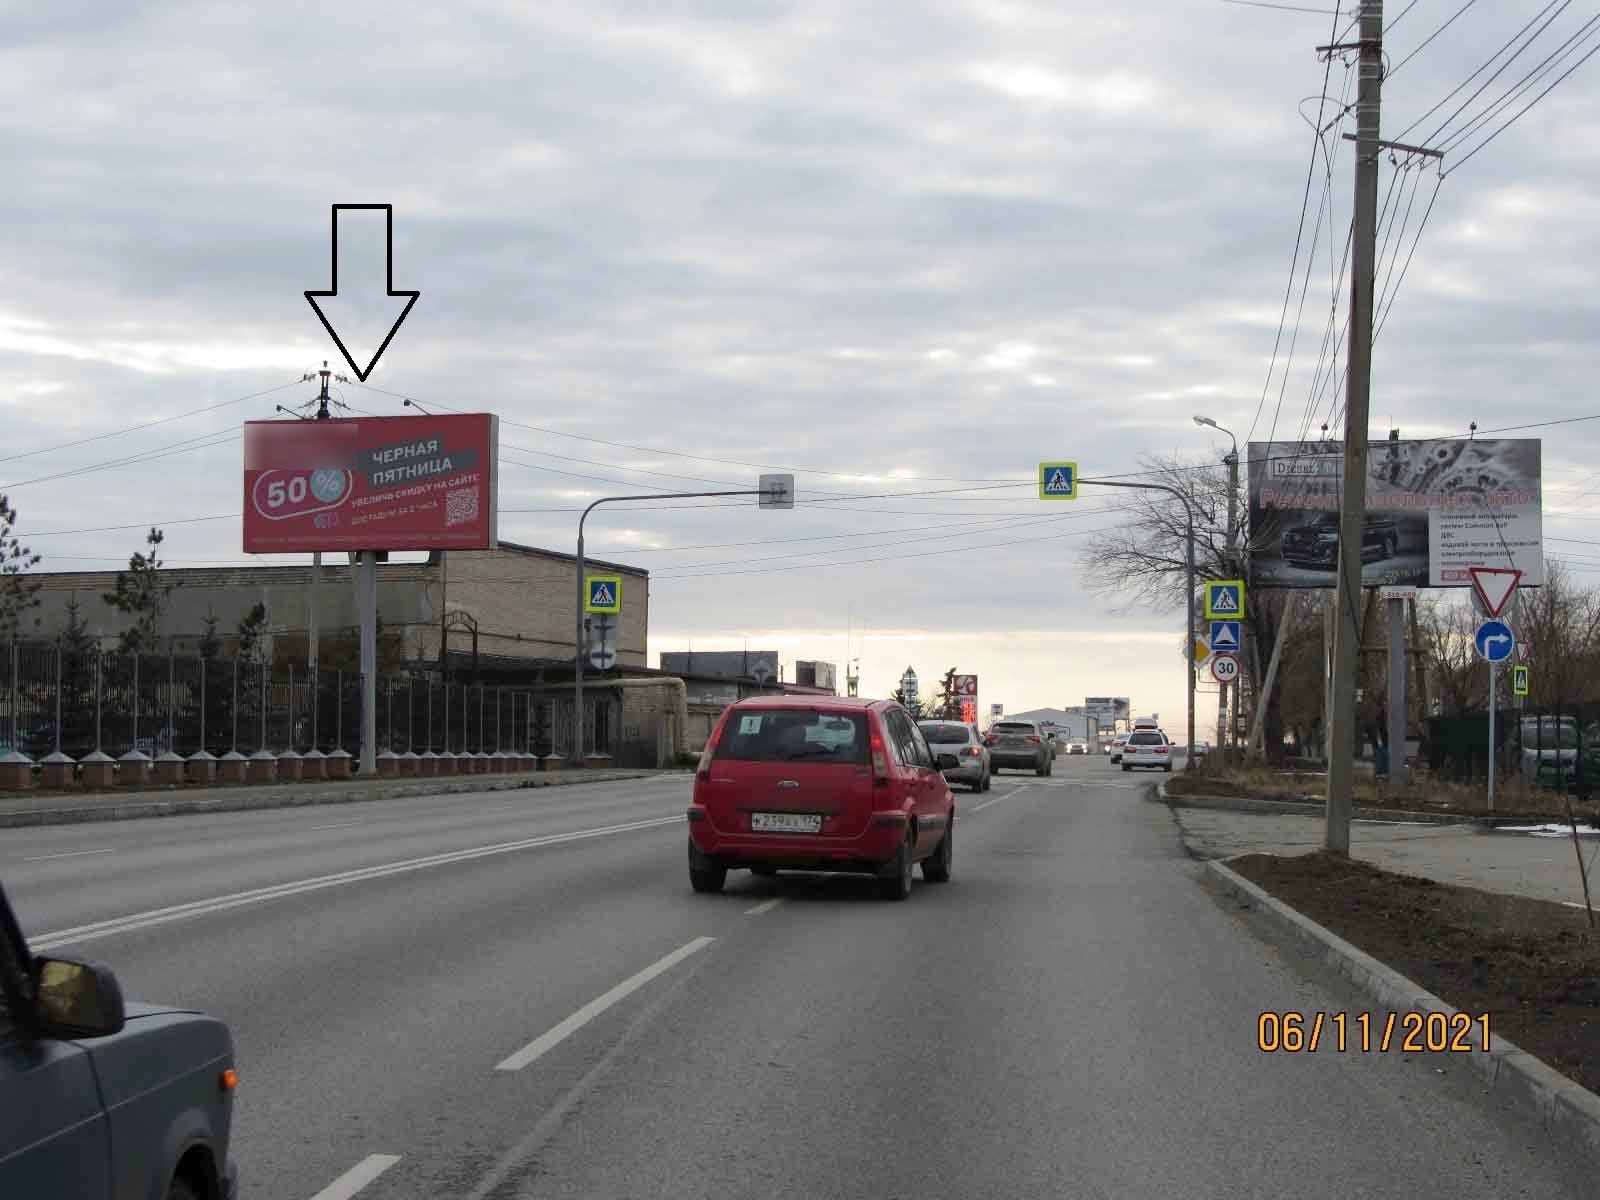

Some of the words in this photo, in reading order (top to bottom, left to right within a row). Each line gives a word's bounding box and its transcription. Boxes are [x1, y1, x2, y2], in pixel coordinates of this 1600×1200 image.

[372, 440, 438, 465] ЧЕРНАЯ
[373, 457, 453, 486] ПЯТНИЦА
[267, 475, 307, 508] 50
[1218, 662, 1234, 674] 30
